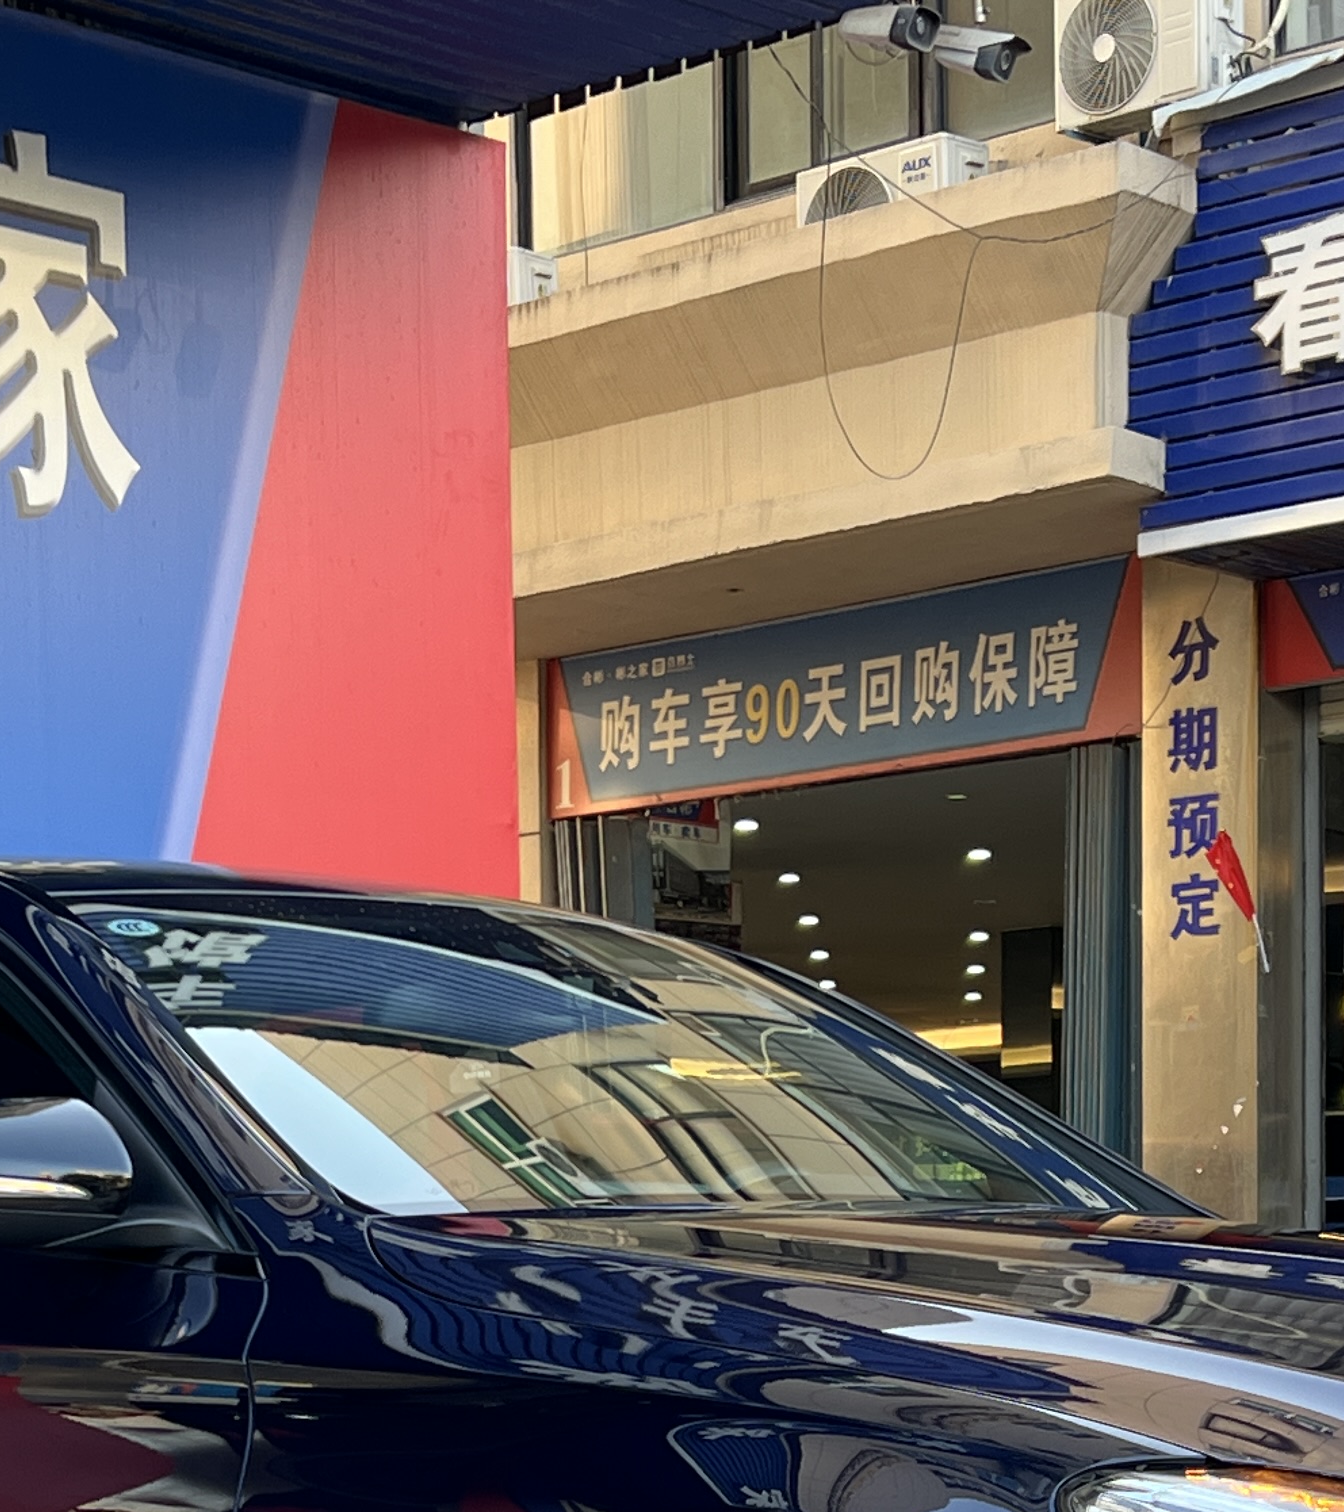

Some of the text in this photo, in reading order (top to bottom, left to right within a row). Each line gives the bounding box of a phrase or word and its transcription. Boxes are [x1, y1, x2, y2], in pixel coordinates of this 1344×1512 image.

[901, 155, 932, 174] AUX
[599, 617, 1081, 775] 购车享90天回购保障
[555, 759, 575, 810] 1
[1168, 617, 1222, 942] 分期预定
